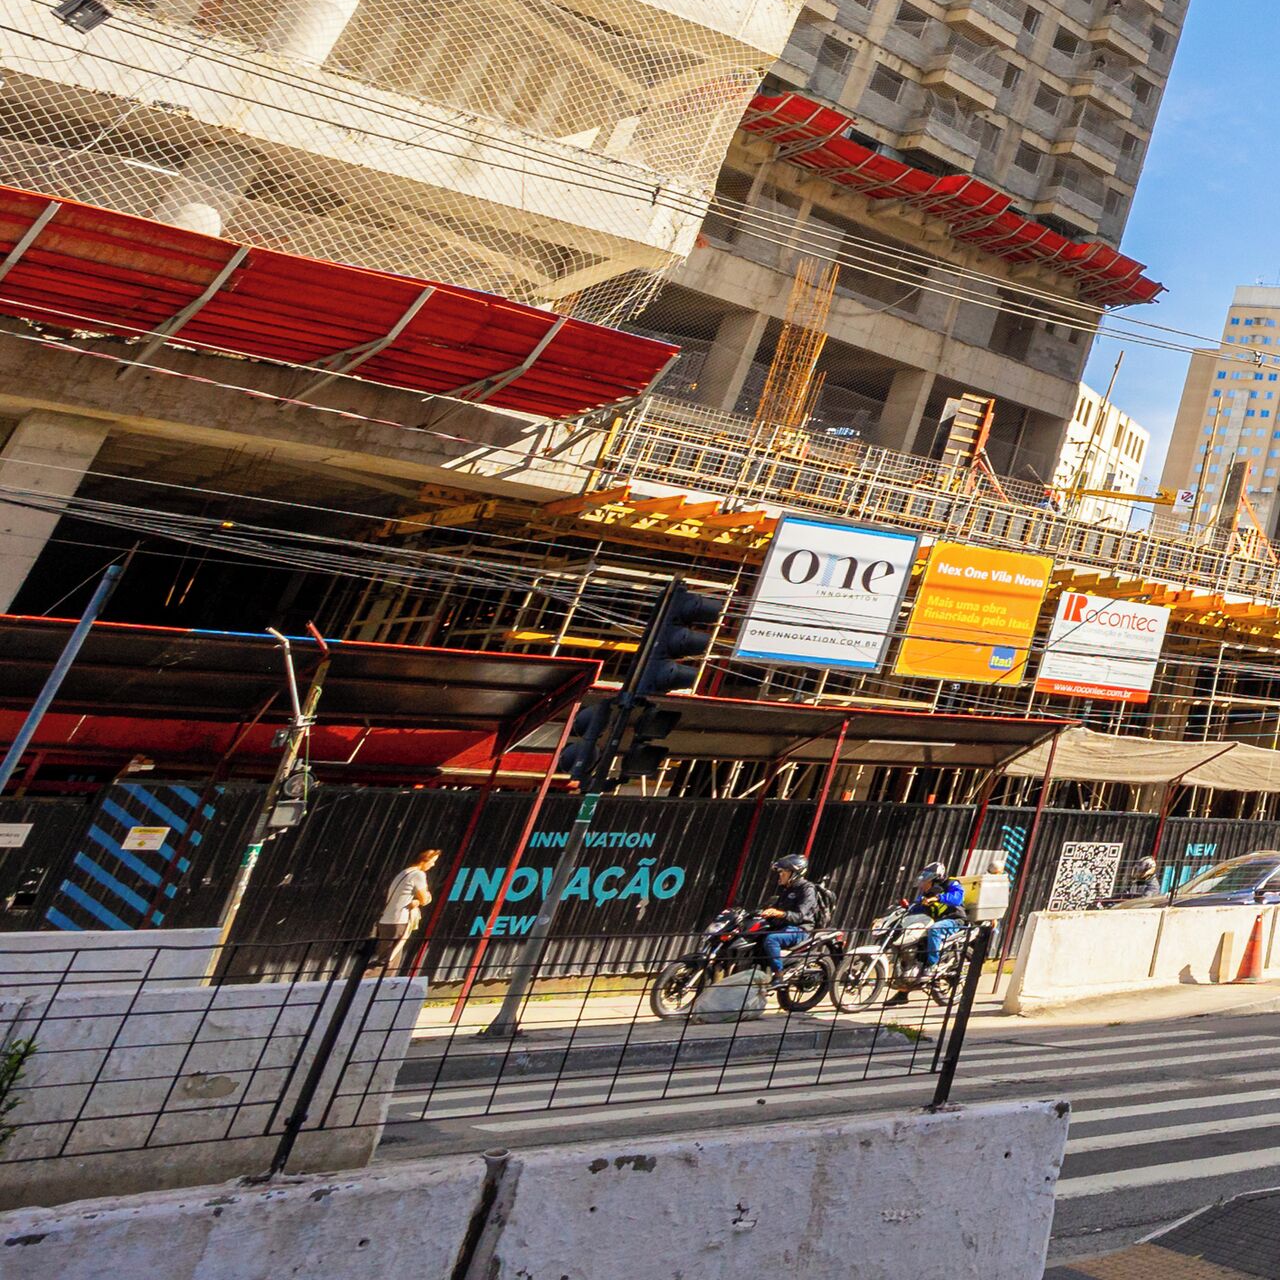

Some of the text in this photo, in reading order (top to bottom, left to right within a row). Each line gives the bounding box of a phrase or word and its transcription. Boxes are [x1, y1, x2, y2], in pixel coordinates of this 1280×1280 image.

[781, 549, 895, 594] one
[937, 562, 1044, 588] Nex One Vila Nova
[816, 589, 879, 602] INNOVATION
[927, 595, 1007, 615] Mais uma obra
[923, 608, 980, 624] financiada
[982, 615, 1006, 627] pelo
[1062, 594, 1158, 633] Rocontec
[750, 628, 878, 648] ONEINNOVATION.COM.BR
[990, 654, 1012, 668] Itaú
[1053, 683, 1132, 699] www.rocontec.com.br
[529, 831, 656, 848] INNVATION
[1186, 843, 1218, 857] NEW
[468, 915, 538, 936] NEW
